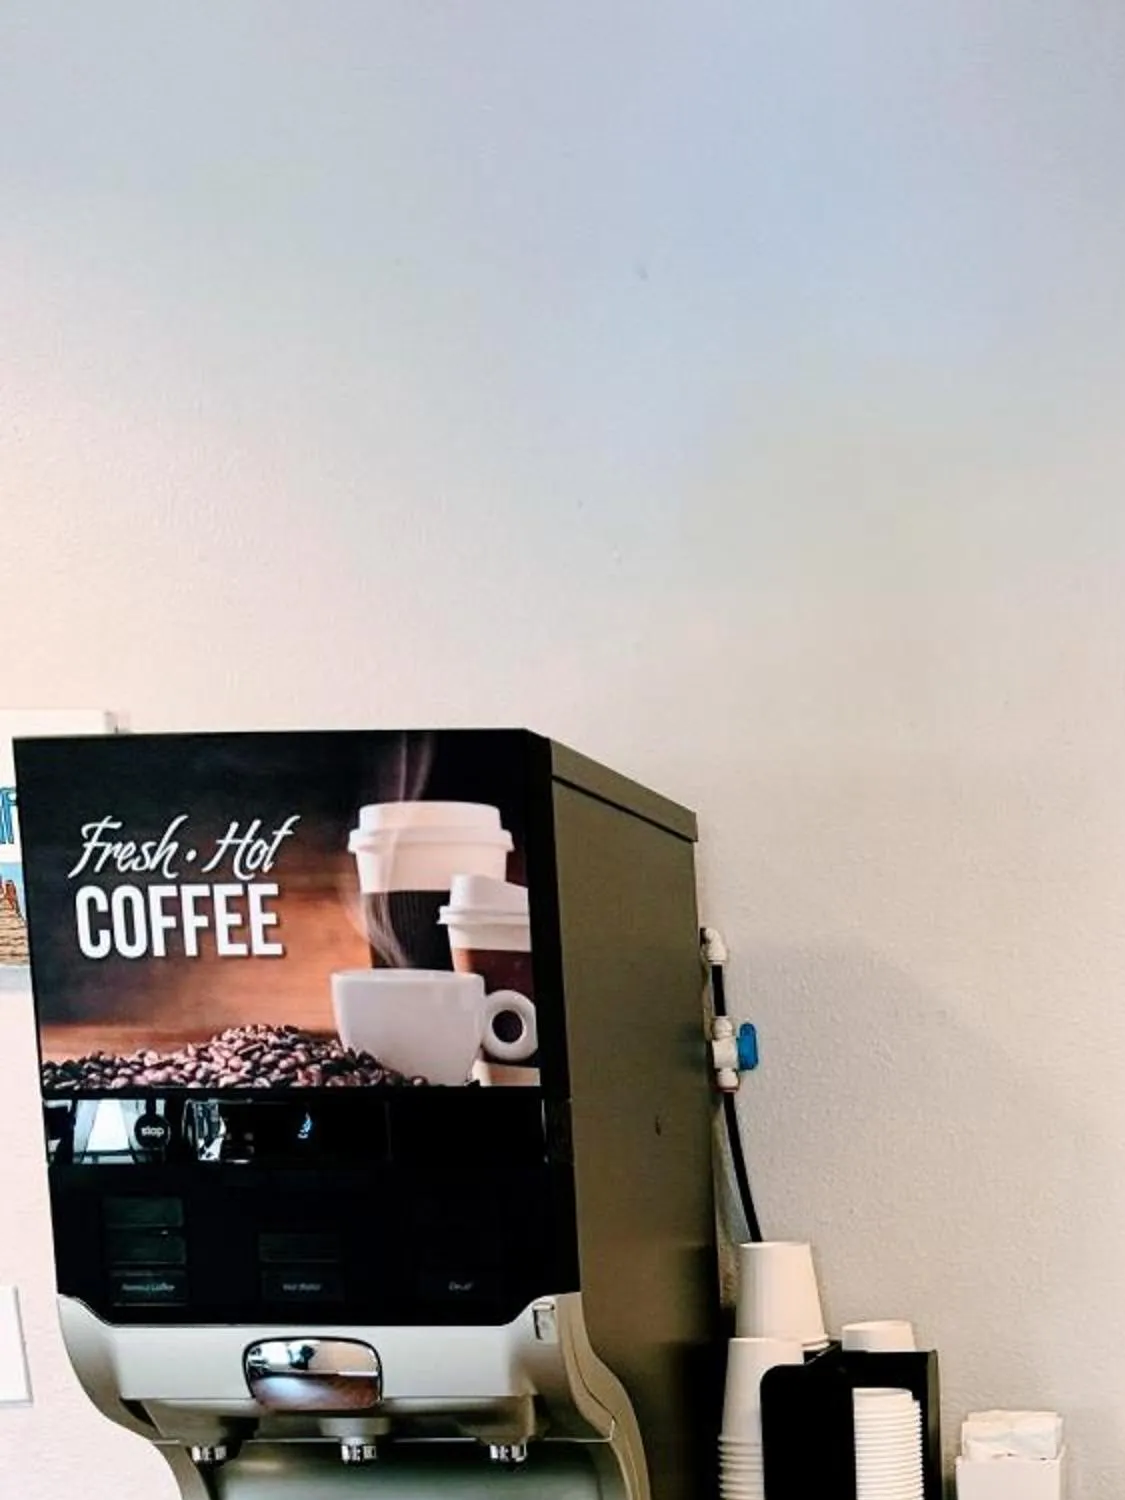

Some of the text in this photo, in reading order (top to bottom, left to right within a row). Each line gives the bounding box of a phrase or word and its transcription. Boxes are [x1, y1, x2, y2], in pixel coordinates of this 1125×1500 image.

[68, 815, 189, 879] Fresh
[202, 815, 300, 879] Hot
[76, 883, 284, 959] COFFEE
